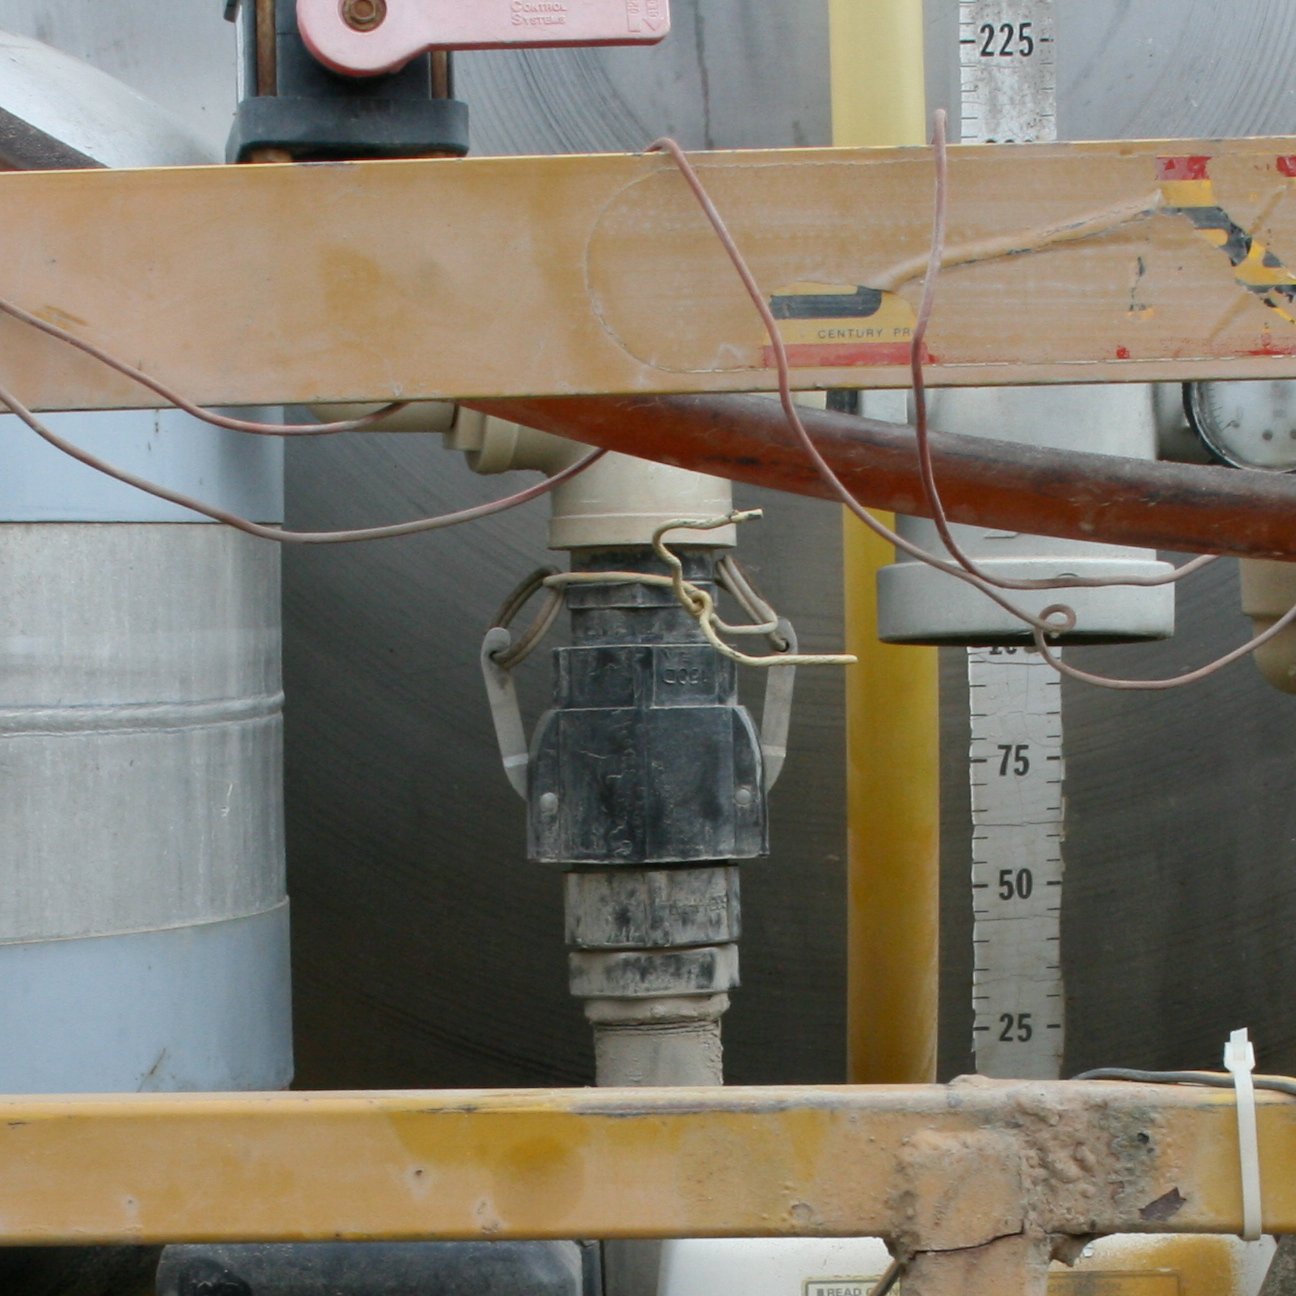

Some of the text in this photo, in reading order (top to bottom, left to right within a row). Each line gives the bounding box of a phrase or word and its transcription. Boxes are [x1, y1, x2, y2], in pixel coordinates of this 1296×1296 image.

[979, 22, 1035, 57] 225
[817, 327, 912, 339] CENTURY PR
[997, 744, 1030, 777] 75
[998, 868, 1033, 900] 50
[998, 1013, 1033, 1043] 25
[827, 1288, 862, 1296] READ
